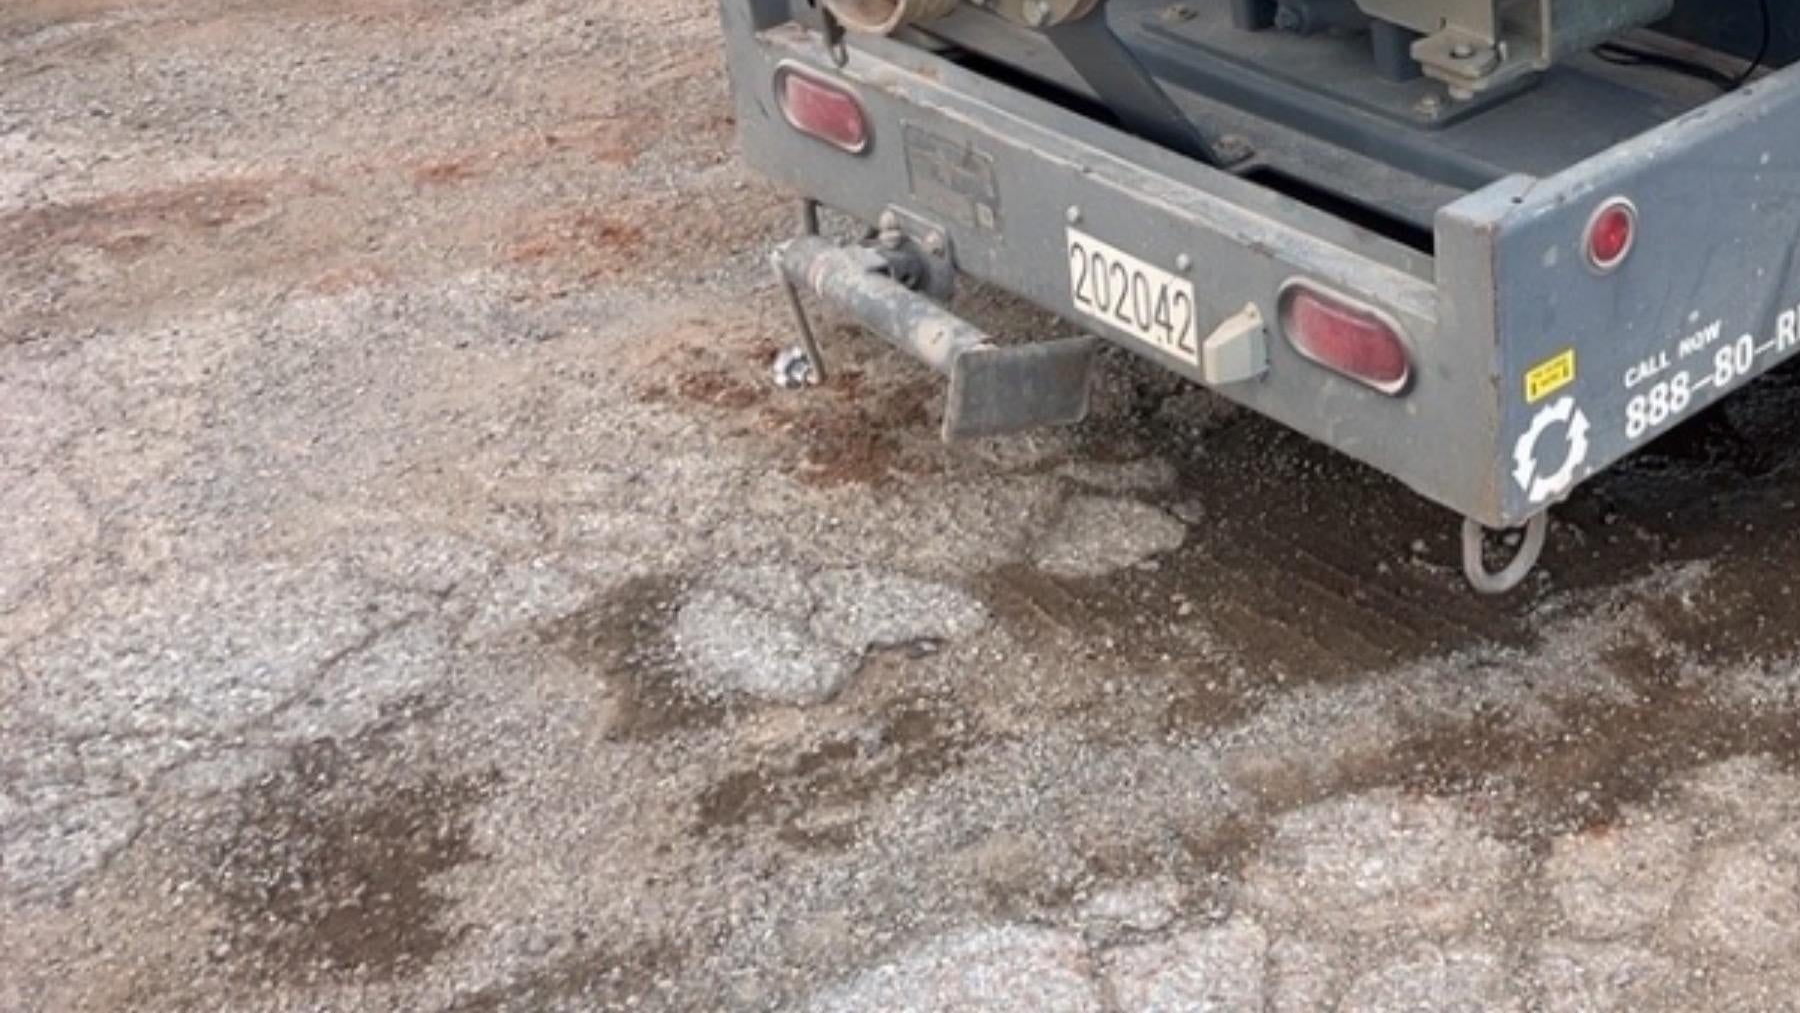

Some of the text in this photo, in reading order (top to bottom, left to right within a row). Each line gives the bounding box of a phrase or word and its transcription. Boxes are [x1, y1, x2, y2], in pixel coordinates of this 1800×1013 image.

[1071, 242, 1195, 354] 202042
[1625, 319, 1722, 388] CALL NOW
